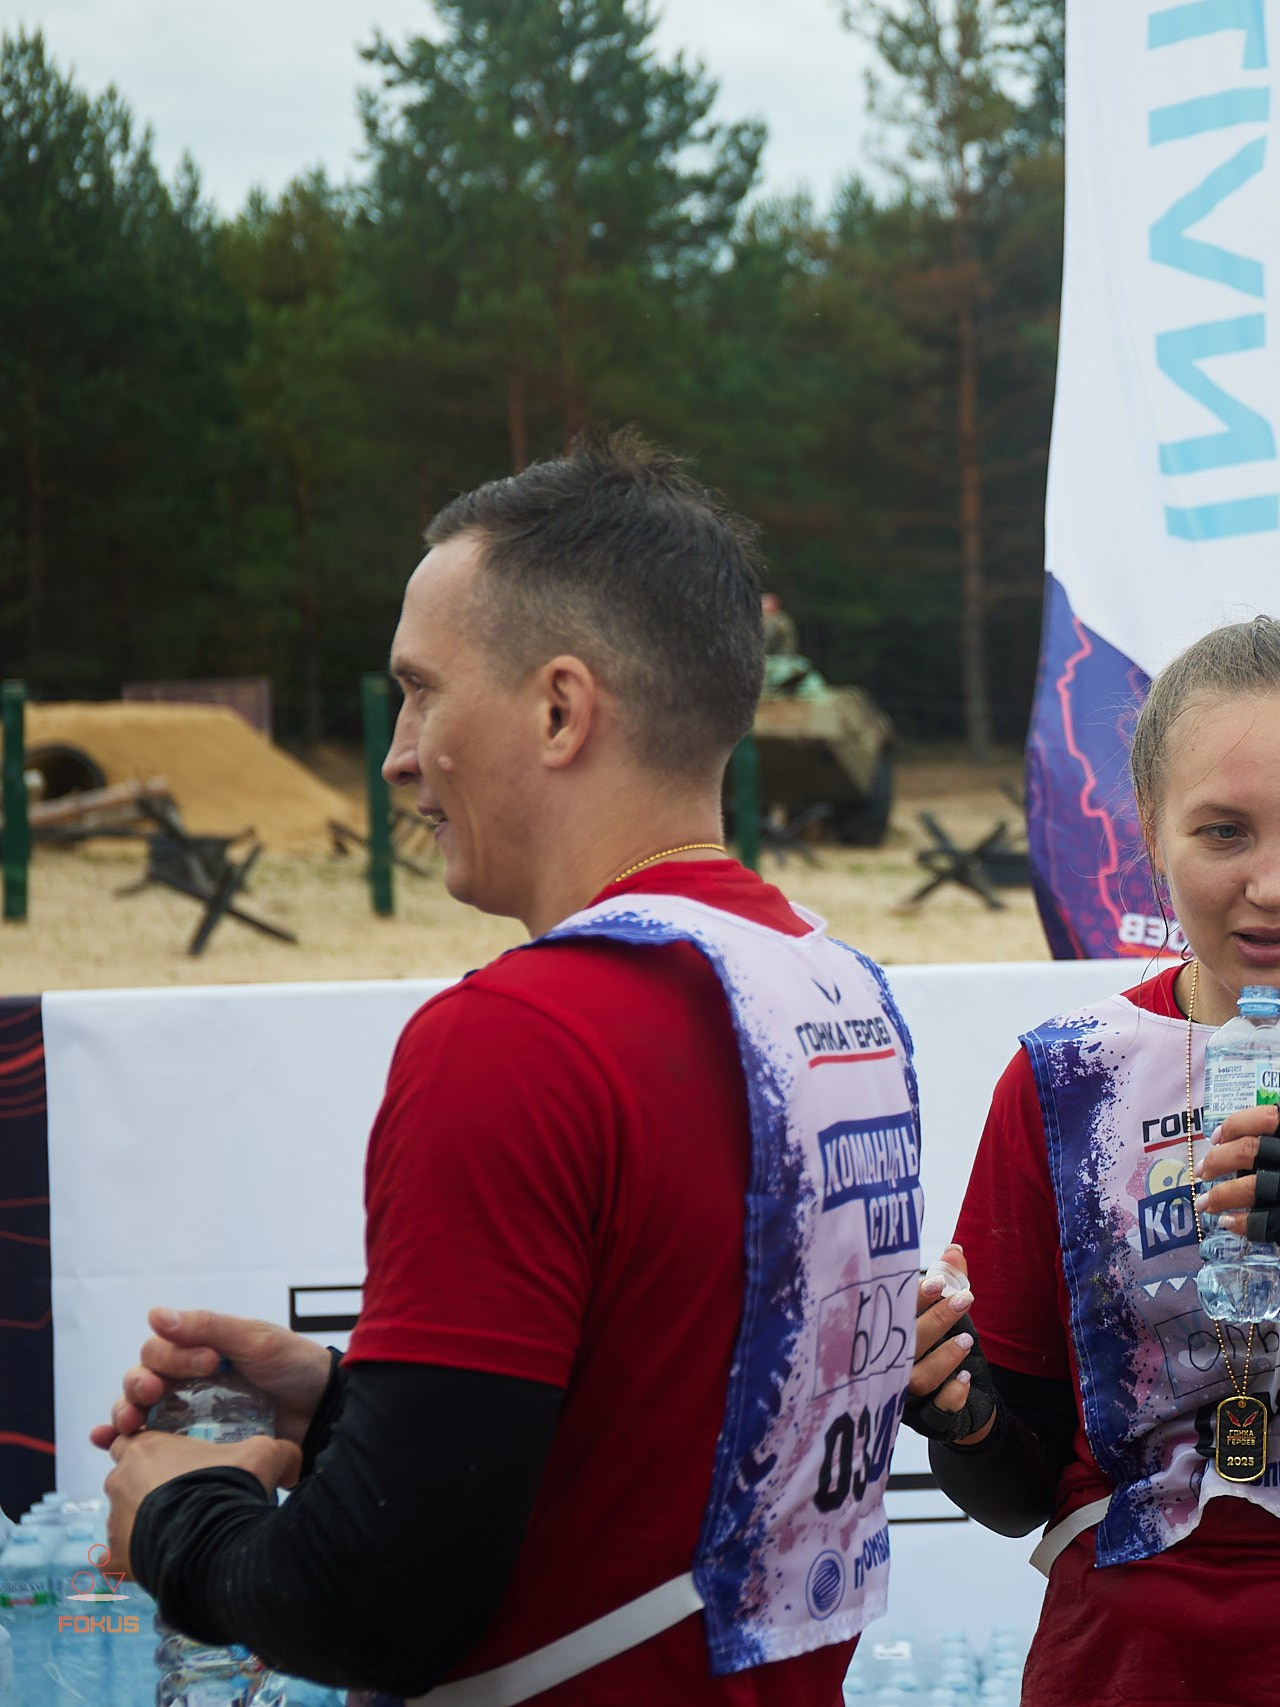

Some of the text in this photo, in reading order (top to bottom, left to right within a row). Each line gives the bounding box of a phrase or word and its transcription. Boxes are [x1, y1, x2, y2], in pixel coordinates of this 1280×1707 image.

[795, 1021, 850, 1057] ГОНКА
[1142, 1106, 1205, 1143] ГОН
[1229, 1429, 1254, 1437] ГОНКА
[1226, 1438, 1256, 1446] ГЕРОЕВ
[1226, 1456, 1255, 1467] 2025
